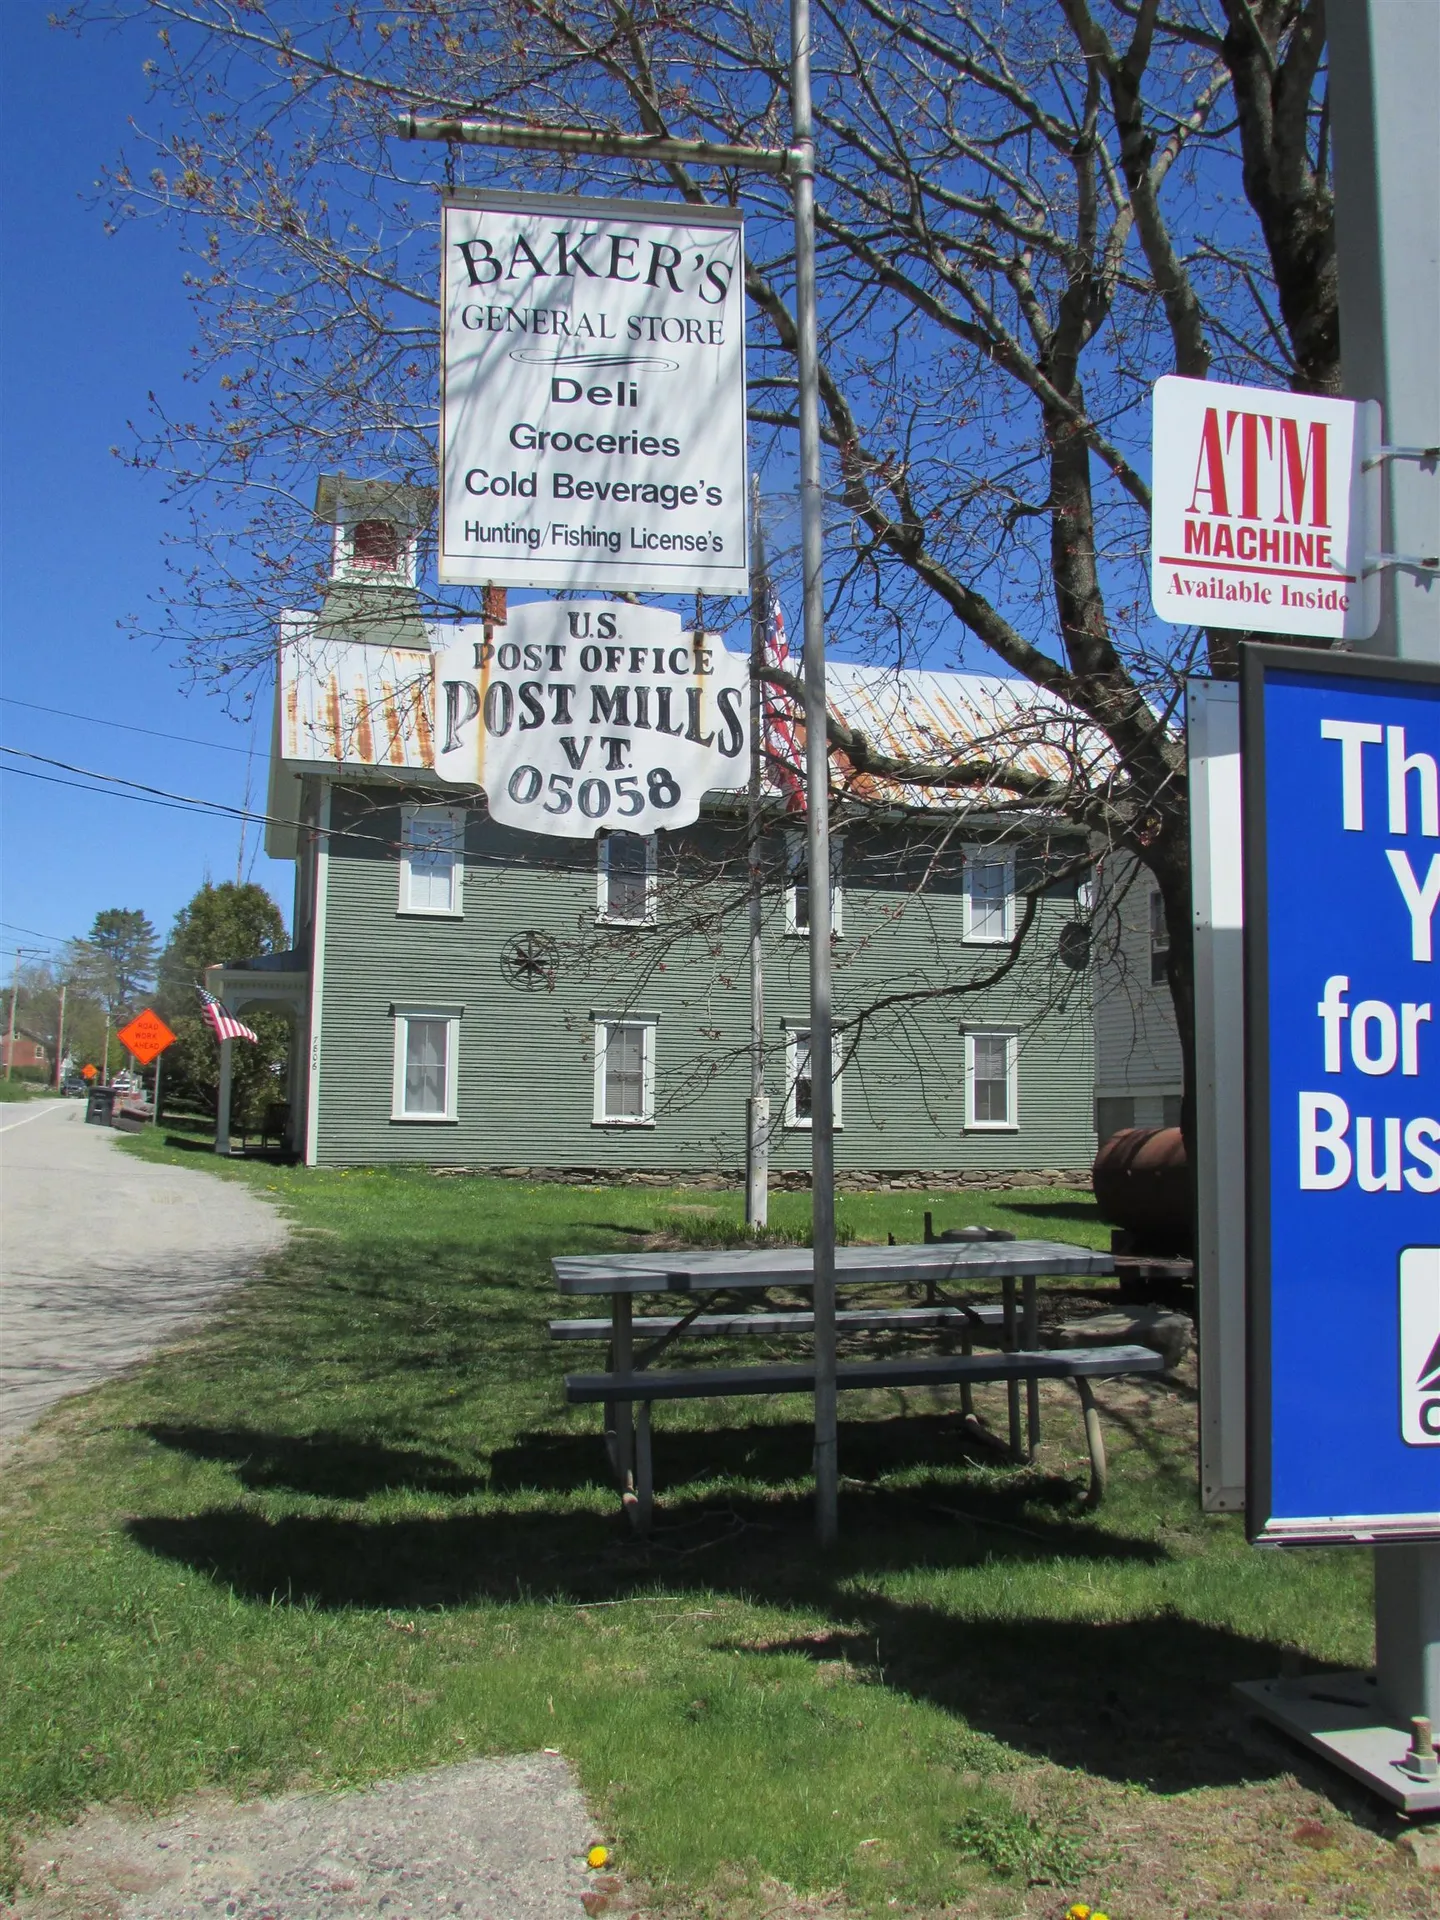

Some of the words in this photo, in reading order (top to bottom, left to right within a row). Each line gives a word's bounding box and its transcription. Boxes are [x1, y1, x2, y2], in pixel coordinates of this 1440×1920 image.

[453, 231, 733, 304] BAKER'S
[461, 304, 616, 339] GENERAL
[627, 315, 726, 346] STORE
[551, 377, 638, 408] Deli
[509, 423, 681, 457] Groceries
[1185, 407, 1332, 529] ATM
[465, 468, 537, 498] Cold
[552, 472, 723, 511] Beverage's
[464, 520, 621, 553] Hunting/Fishing
[630, 527, 723, 553] License's
[1184, 519, 1332, 569] MACHINE
[1167, 572, 1272, 605] Available
[1280, 584, 1350, 613] Inside
[567, 611, 623, 640] U.S.
[472, 642, 567, 673] POST
[580, 644, 715, 676] OFFICE
[441, 680, 577, 755] POST
[589, 684, 743, 759] MILLS
[507, 764, 682, 819] 05058
[1320, 719, 1440, 837] Th
[133, 1041, 160, 1050] AHEAD
[135, 1032, 157, 1040] WORK
[138, 1022, 159, 1031] ROAD
[1317, 975, 1432, 1076] for
[1299, 1091, 1440, 1193] Bus
